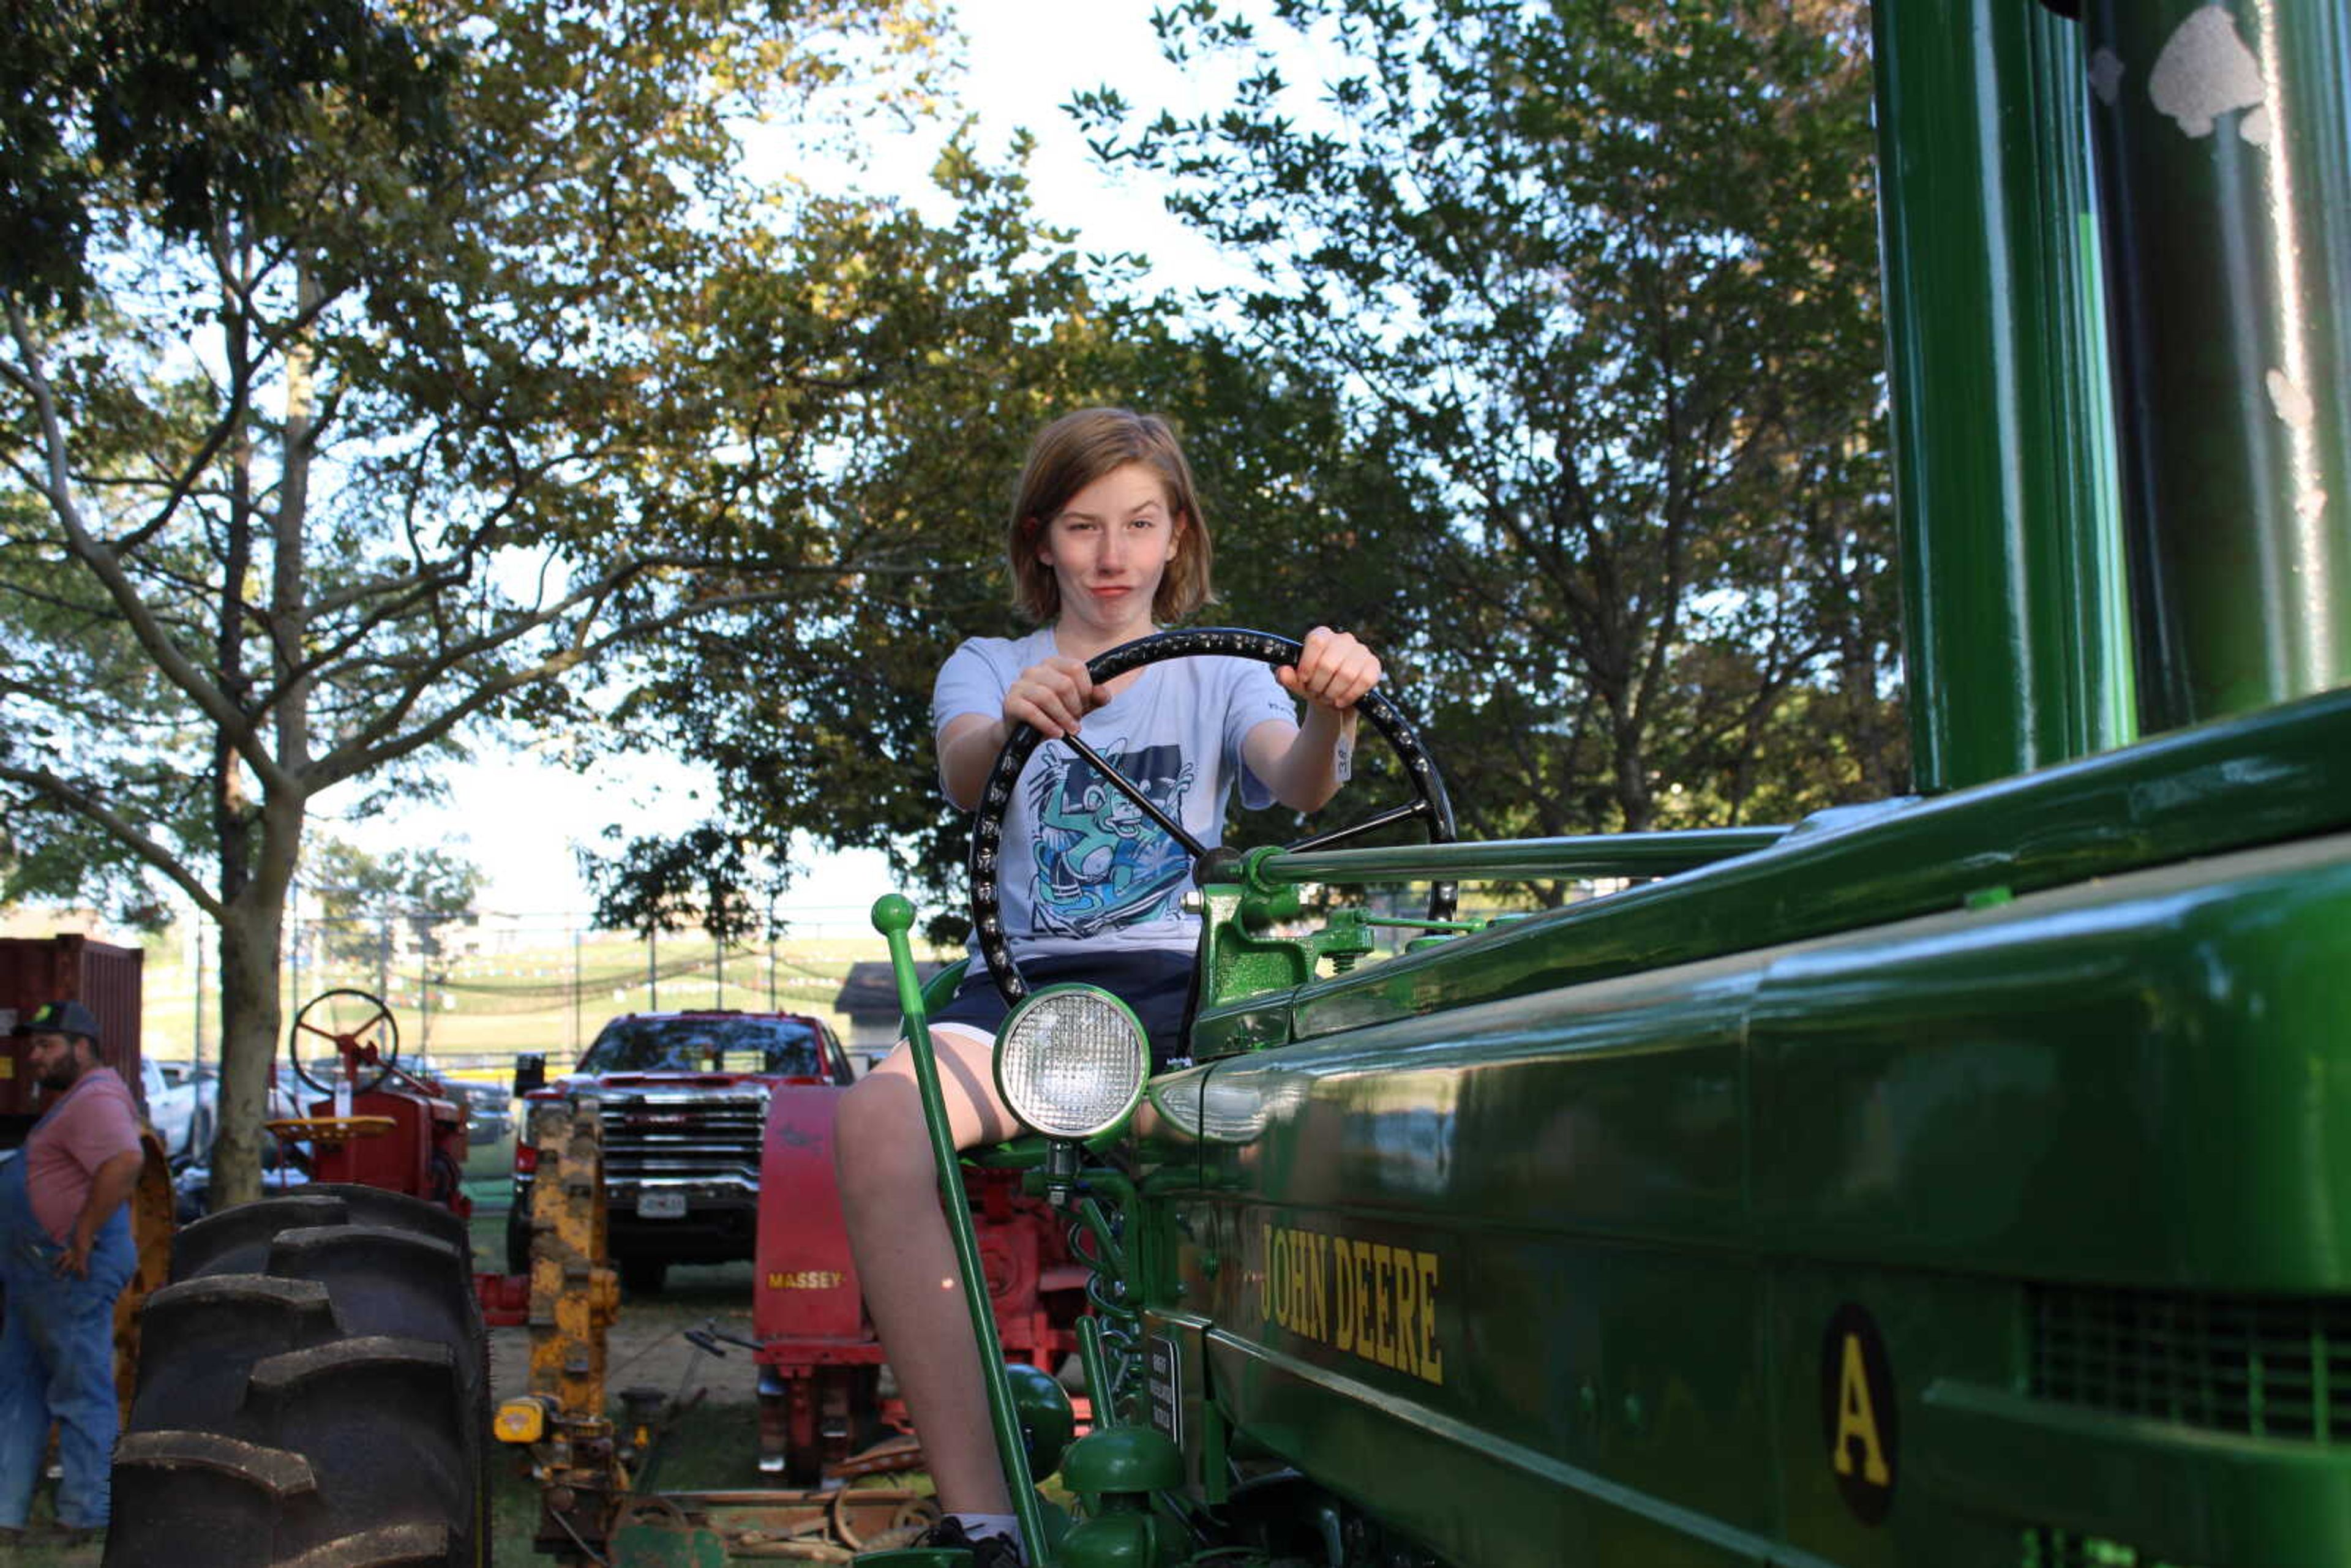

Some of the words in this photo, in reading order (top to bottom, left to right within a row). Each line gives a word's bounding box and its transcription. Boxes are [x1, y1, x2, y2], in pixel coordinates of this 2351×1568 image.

[1261, 1223, 1327, 1343] JOHN
[1333, 1235, 1444, 1386] DEERE
[1834, 1332, 1891, 1487] A
